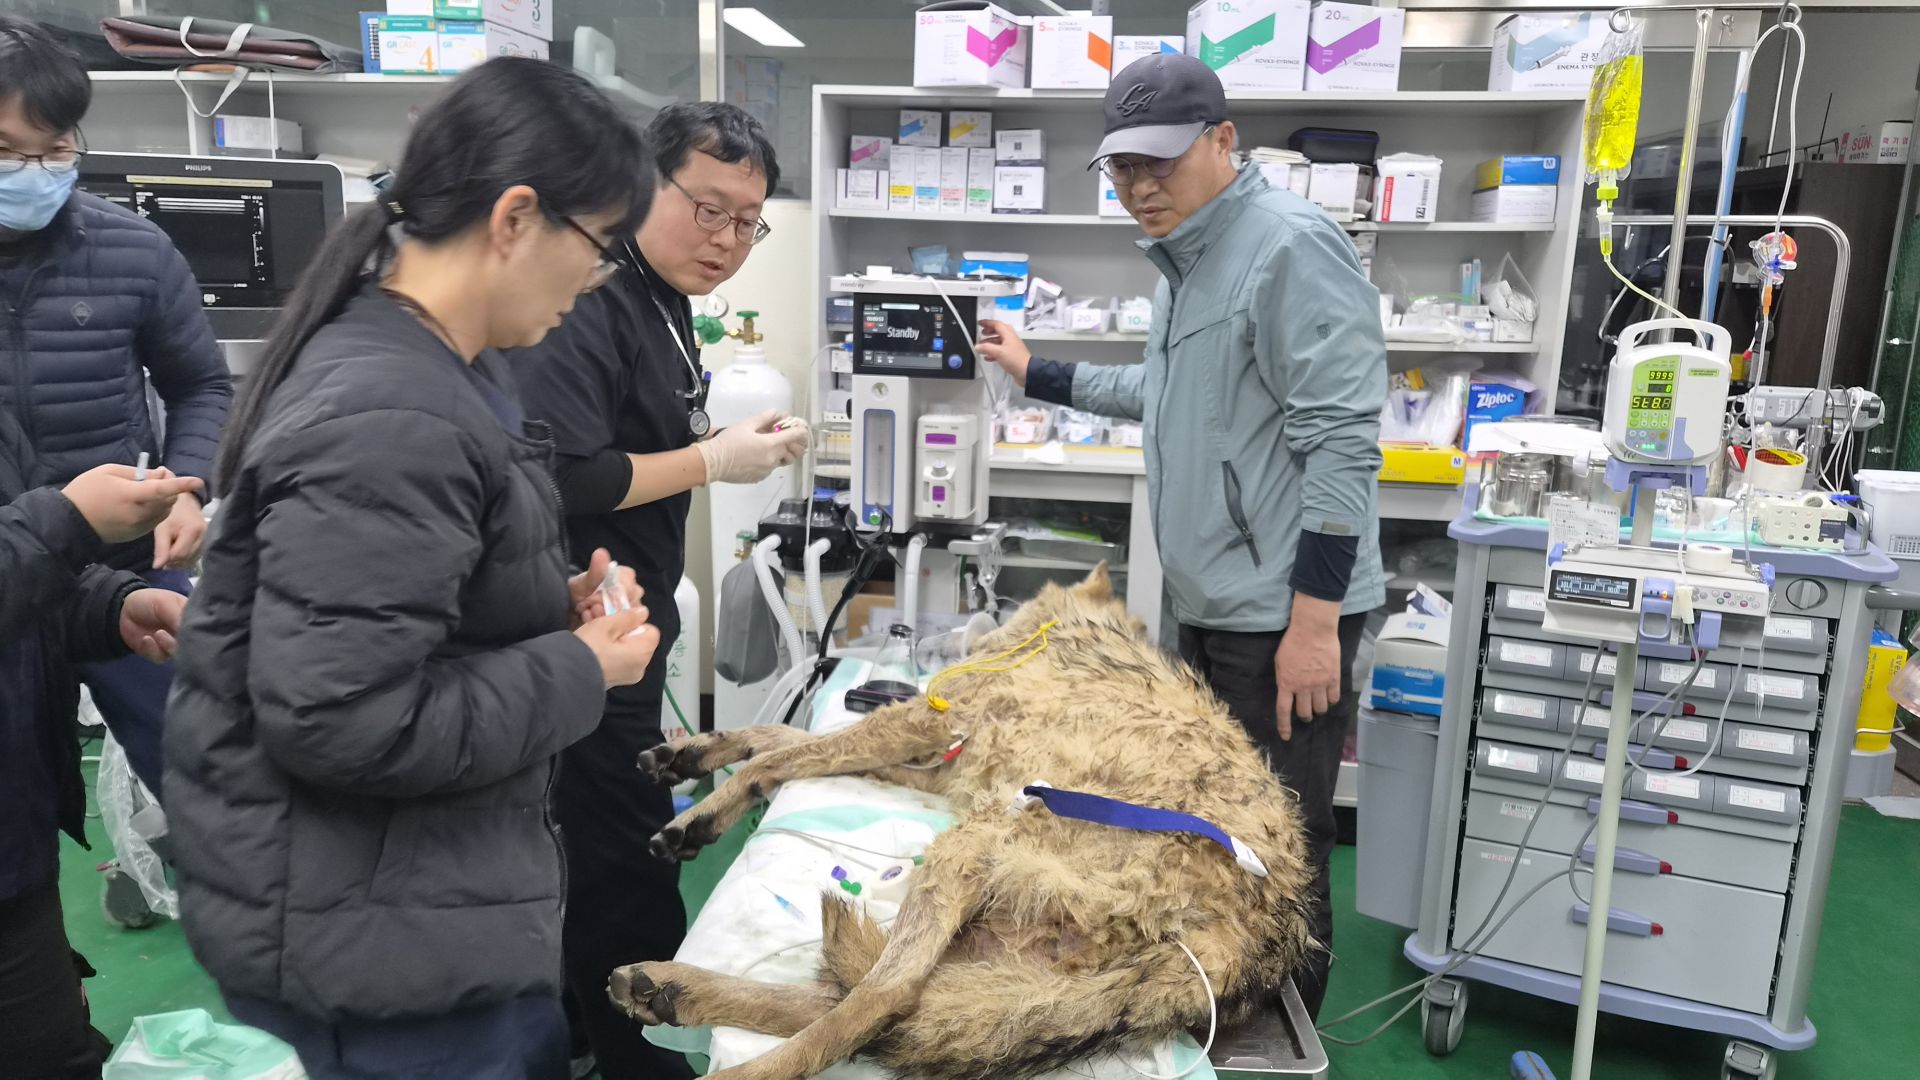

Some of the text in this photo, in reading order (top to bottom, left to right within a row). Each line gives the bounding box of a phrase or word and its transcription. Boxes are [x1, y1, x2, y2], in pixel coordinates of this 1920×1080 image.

[418, 44, 435, 71] 4
[1116, 83, 1158, 117] LA
[185, 164, 212, 172] PHILIPS
[887, 327, 920, 340] Standby
[1649, 370, 1674, 380] 9999
[1476, 391, 1515, 409] Ziploc
[1453, 457, 1462, 466] M
